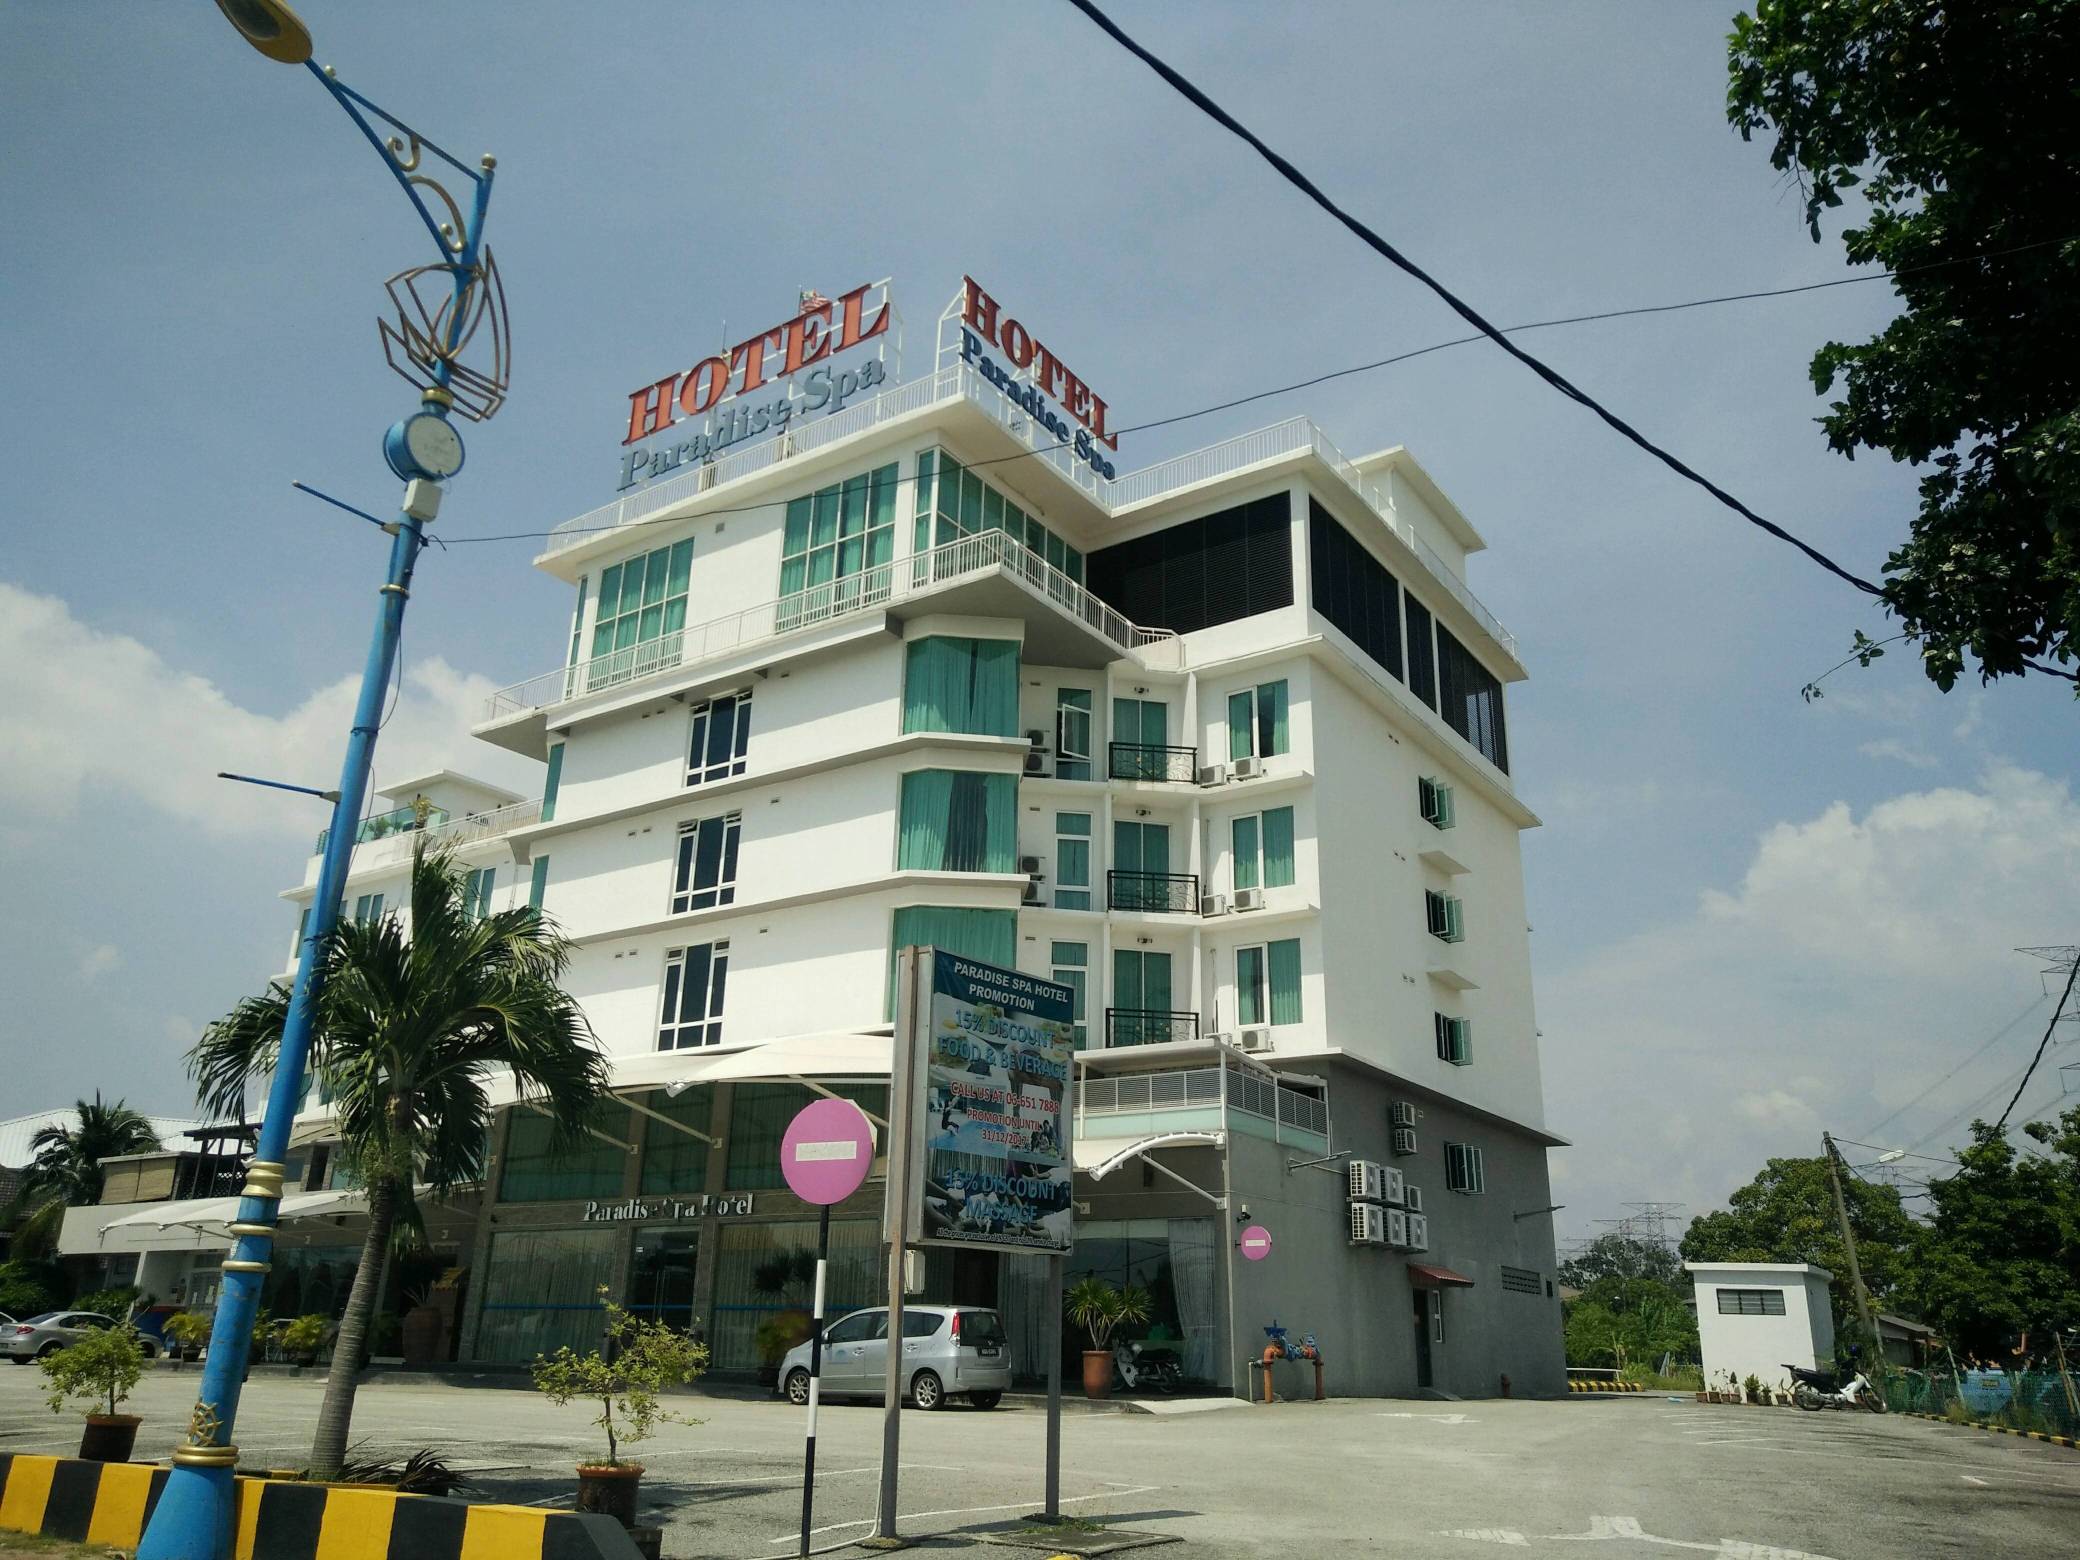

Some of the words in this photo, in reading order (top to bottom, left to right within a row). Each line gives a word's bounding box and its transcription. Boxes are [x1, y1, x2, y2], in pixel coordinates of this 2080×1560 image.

[622, 283, 890, 446] HOTEL
[961, 274, 1118, 451] HOTEL
[959, 326, 1070, 442] Paradise
[1075, 429, 1115, 480] Spa
[616, 397, 792, 491] Paradise
[801, 358, 886, 415] Spa
[954, 962, 1010, 987] PARADISE
[1012, 977, 1032, 994] SPA
[1035, 984, 1069, 1002] HOTEL
[969, 983, 1035, 1011] PROMOTION
[955, 1008, 984, 1033] 15%
[988, 1018, 1055, 1049] DISCOUNT
[938, 1036, 981, 1063] FOOD
[985, 1047, 997, 1066] &
[1000, 1053, 1067, 1081] BEVERAGE
[950, 1081, 976, 1098] CALL
[978, 1087, 990, 1102] US
[992, 1090, 1004, 1105] AT
[1006, 1092, 1036, 1109] 06-651
[1039, 1098, 1060, 1114] 7888
[967, 1108, 1018, 1129] PROMOTION
[1019, 1118, 1041, 1132] UNTIL
[945, 1167, 977, 1191] 15%
[982, 1174, 1056, 1200] DISCOUNT
[966, 1197, 1038, 1225] MASSAGE
